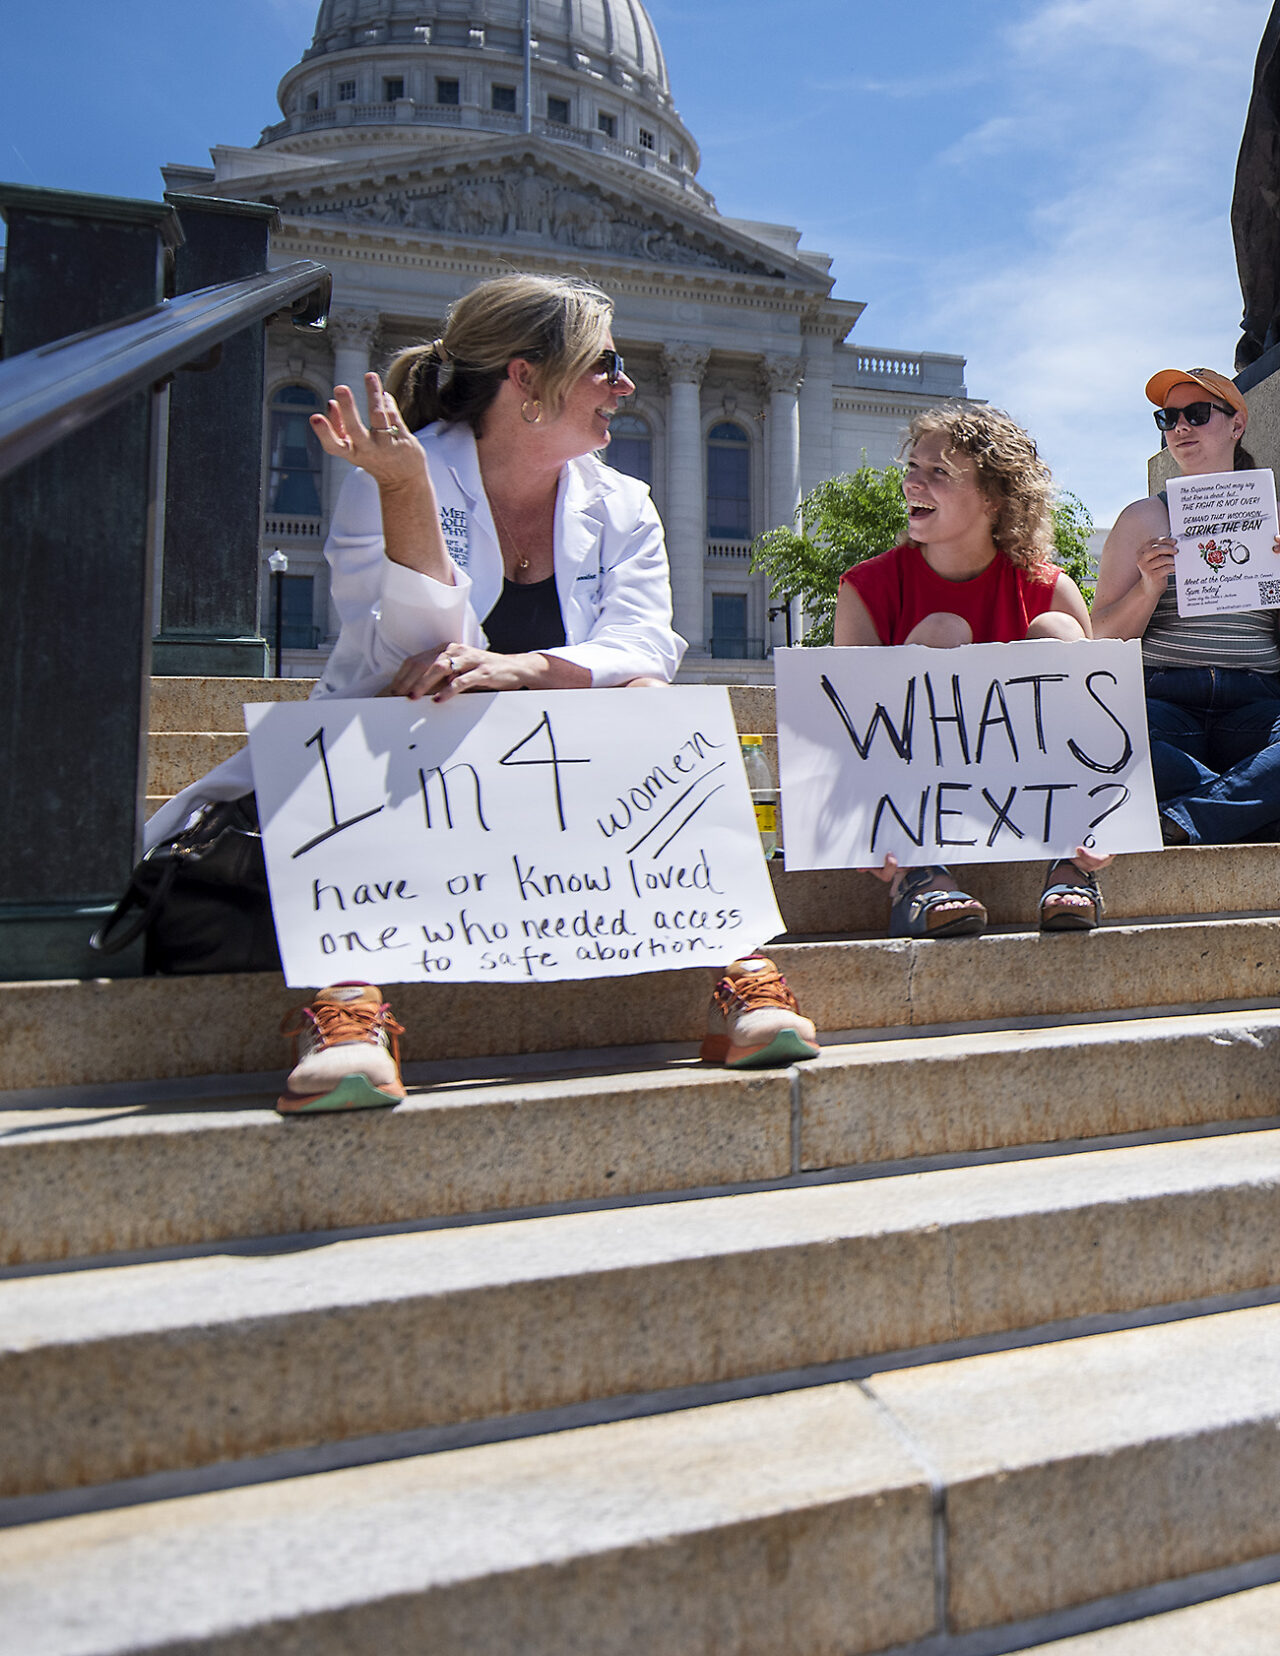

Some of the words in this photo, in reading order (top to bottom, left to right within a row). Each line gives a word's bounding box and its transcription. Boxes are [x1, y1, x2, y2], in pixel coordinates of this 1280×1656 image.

[1182, 503, 1194, 511] THE
[1195, 501, 1215, 509] FIGHT
[1183, 515, 1209, 524] DEMAND
[1184, 524, 1219, 537] STRIKE
[1221, 522, 1240, 533] THE
[1242, 520, 1263, 531] BAN
[1220, 574, 1242, 583] Capitol
[820, 671, 1133, 774] WHATS
[292, 727, 385, 859] 1
[408, 741, 490, 832] in
[498, 710, 592, 832] 4
[596, 729, 725, 839] women
[871, 782, 1132, 853] NEXT?
[312, 878, 418, 910] have
[446, 872, 488, 898] or
[629, 848, 725, 898] loved
[320, 924, 411, 955] one
[421, 908, 509, 946] who
[521, 908, 637, 940] needed
[654, 907, 743, 930] access
[415, 949, 452, 973] to
[480, 944, 559, 977] safe
[576, 935, 725, 961] abortion.
